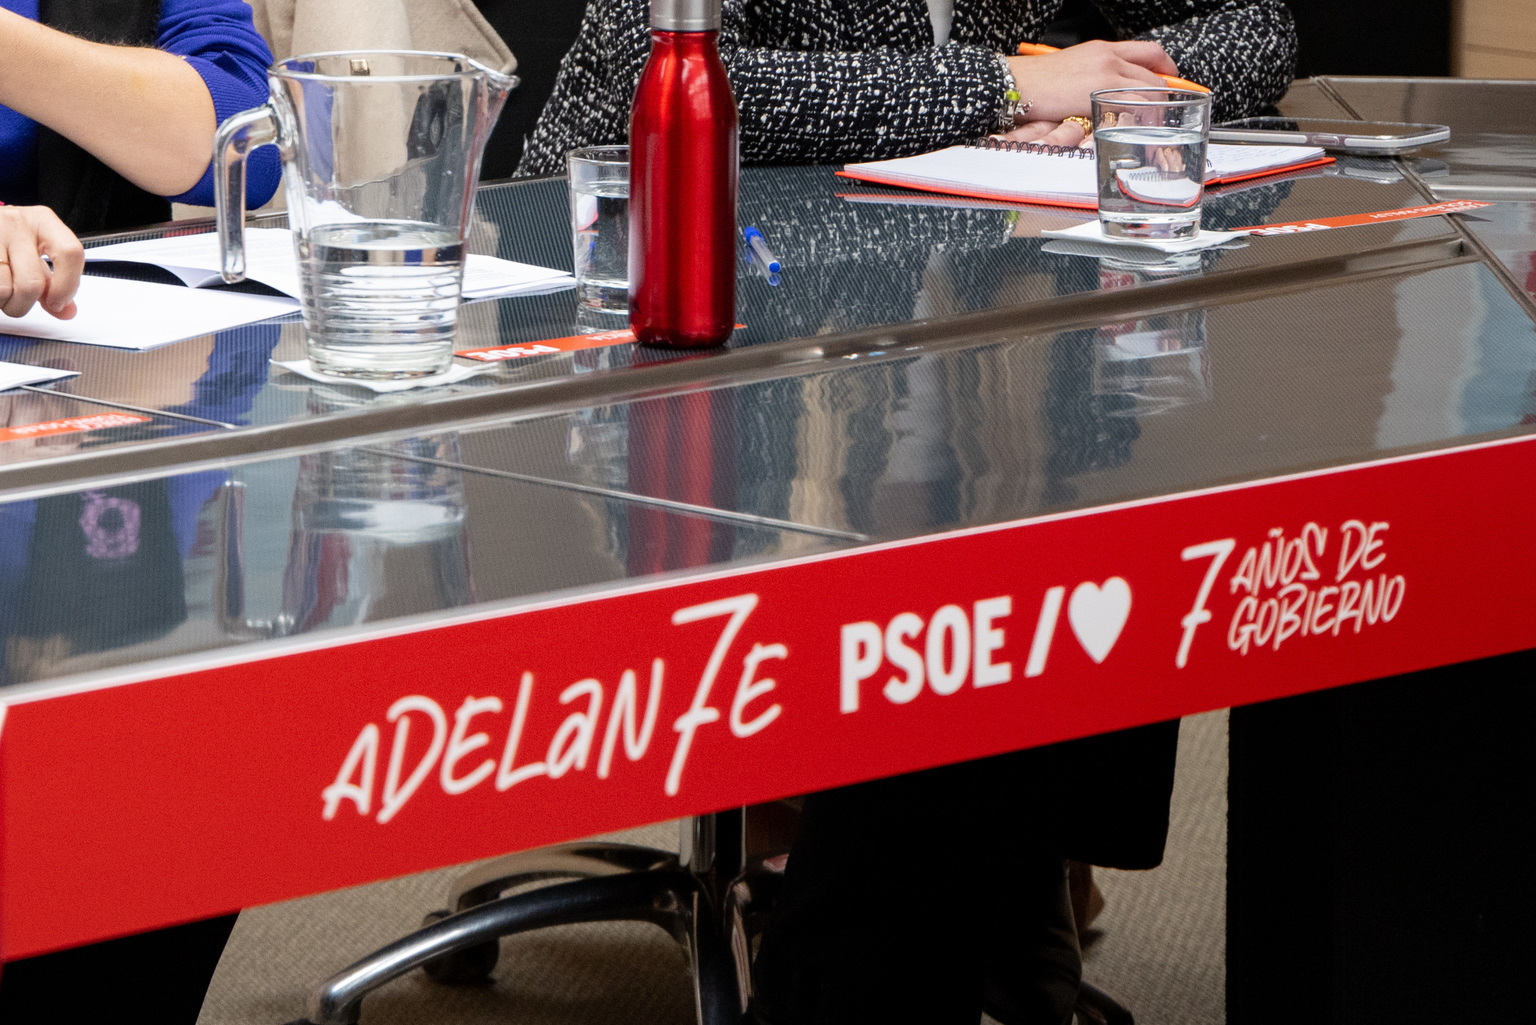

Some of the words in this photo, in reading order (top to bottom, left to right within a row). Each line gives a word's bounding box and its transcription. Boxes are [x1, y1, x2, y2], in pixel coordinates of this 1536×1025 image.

[839, 594, 1013, 715] PSOE
[1175, 537, 1237, 670] 7
[1228, 520, 1329, 598] AÑOS
[1335, 518, 1391, 588] DE
[1226, 573, 1407, 657] GOBIERNO
